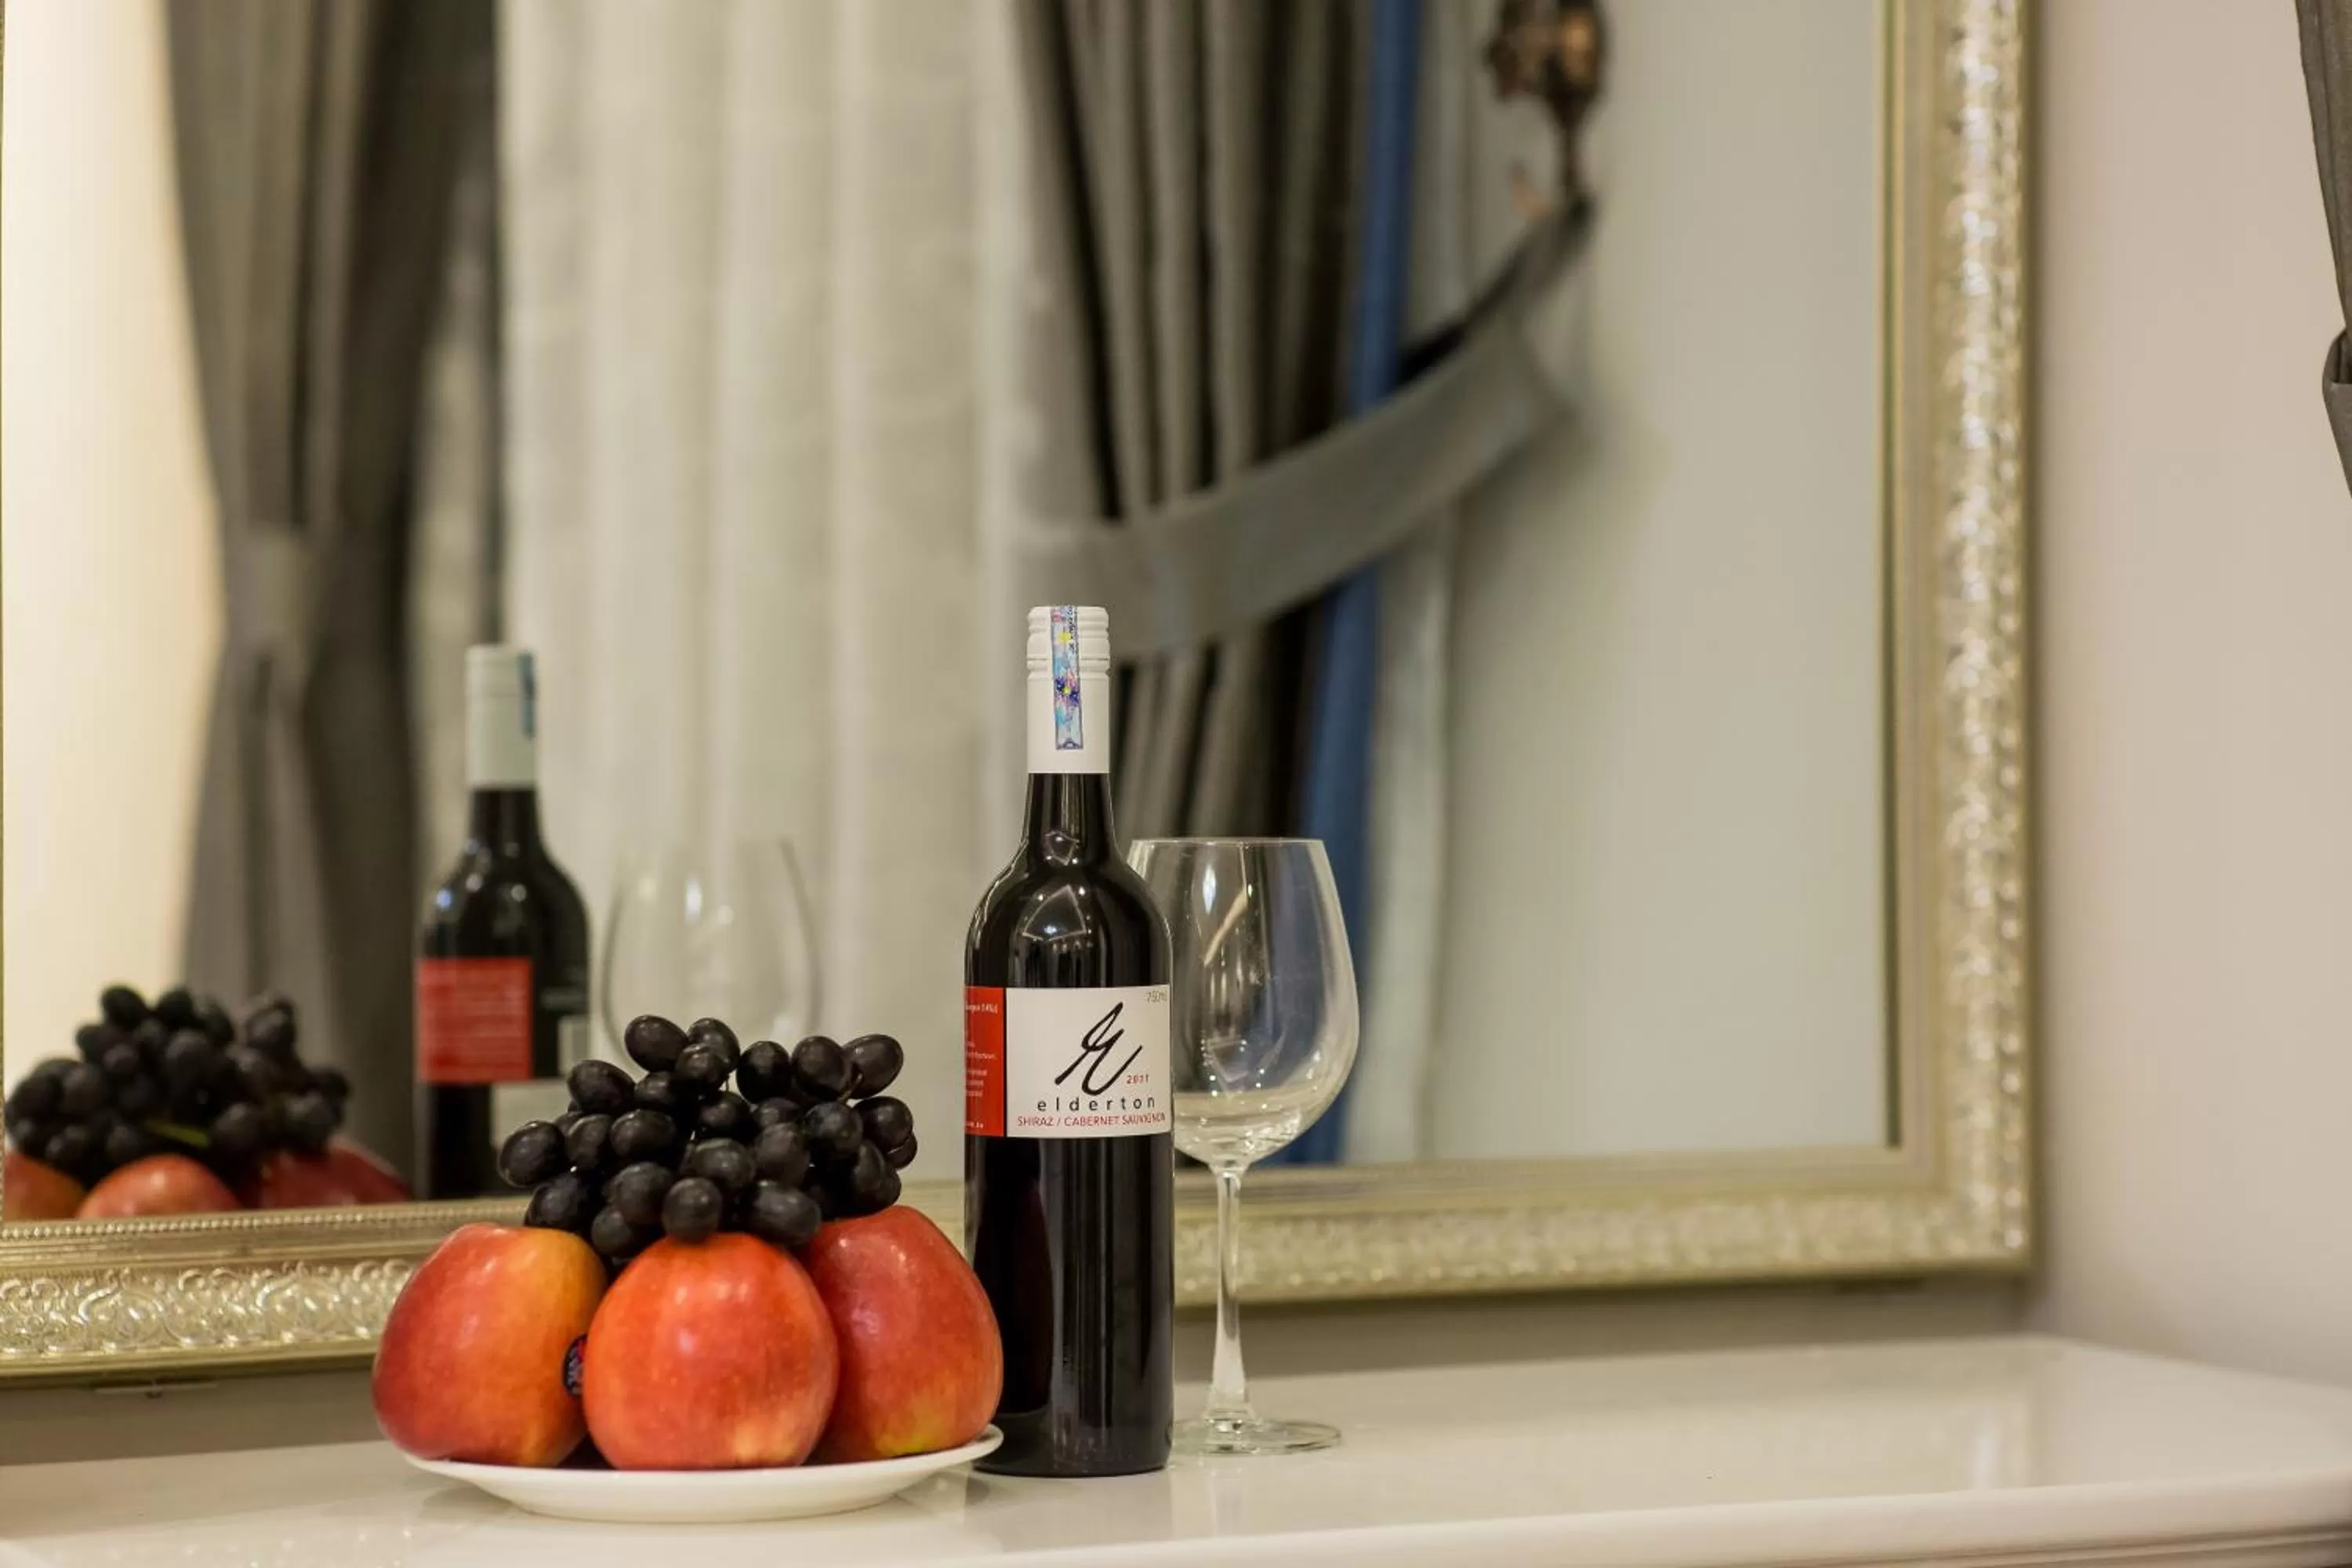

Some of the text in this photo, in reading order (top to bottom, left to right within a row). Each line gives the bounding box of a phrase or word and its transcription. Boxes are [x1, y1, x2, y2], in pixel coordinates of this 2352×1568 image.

[1127, 1073, 1149, 1084] 2011
[1037, 1096, 1155, 1112] elderton
[1017, 1116, 1054, 1127] SHIRAZ
[1064, 1115, 1120, 1127] CABERNET
